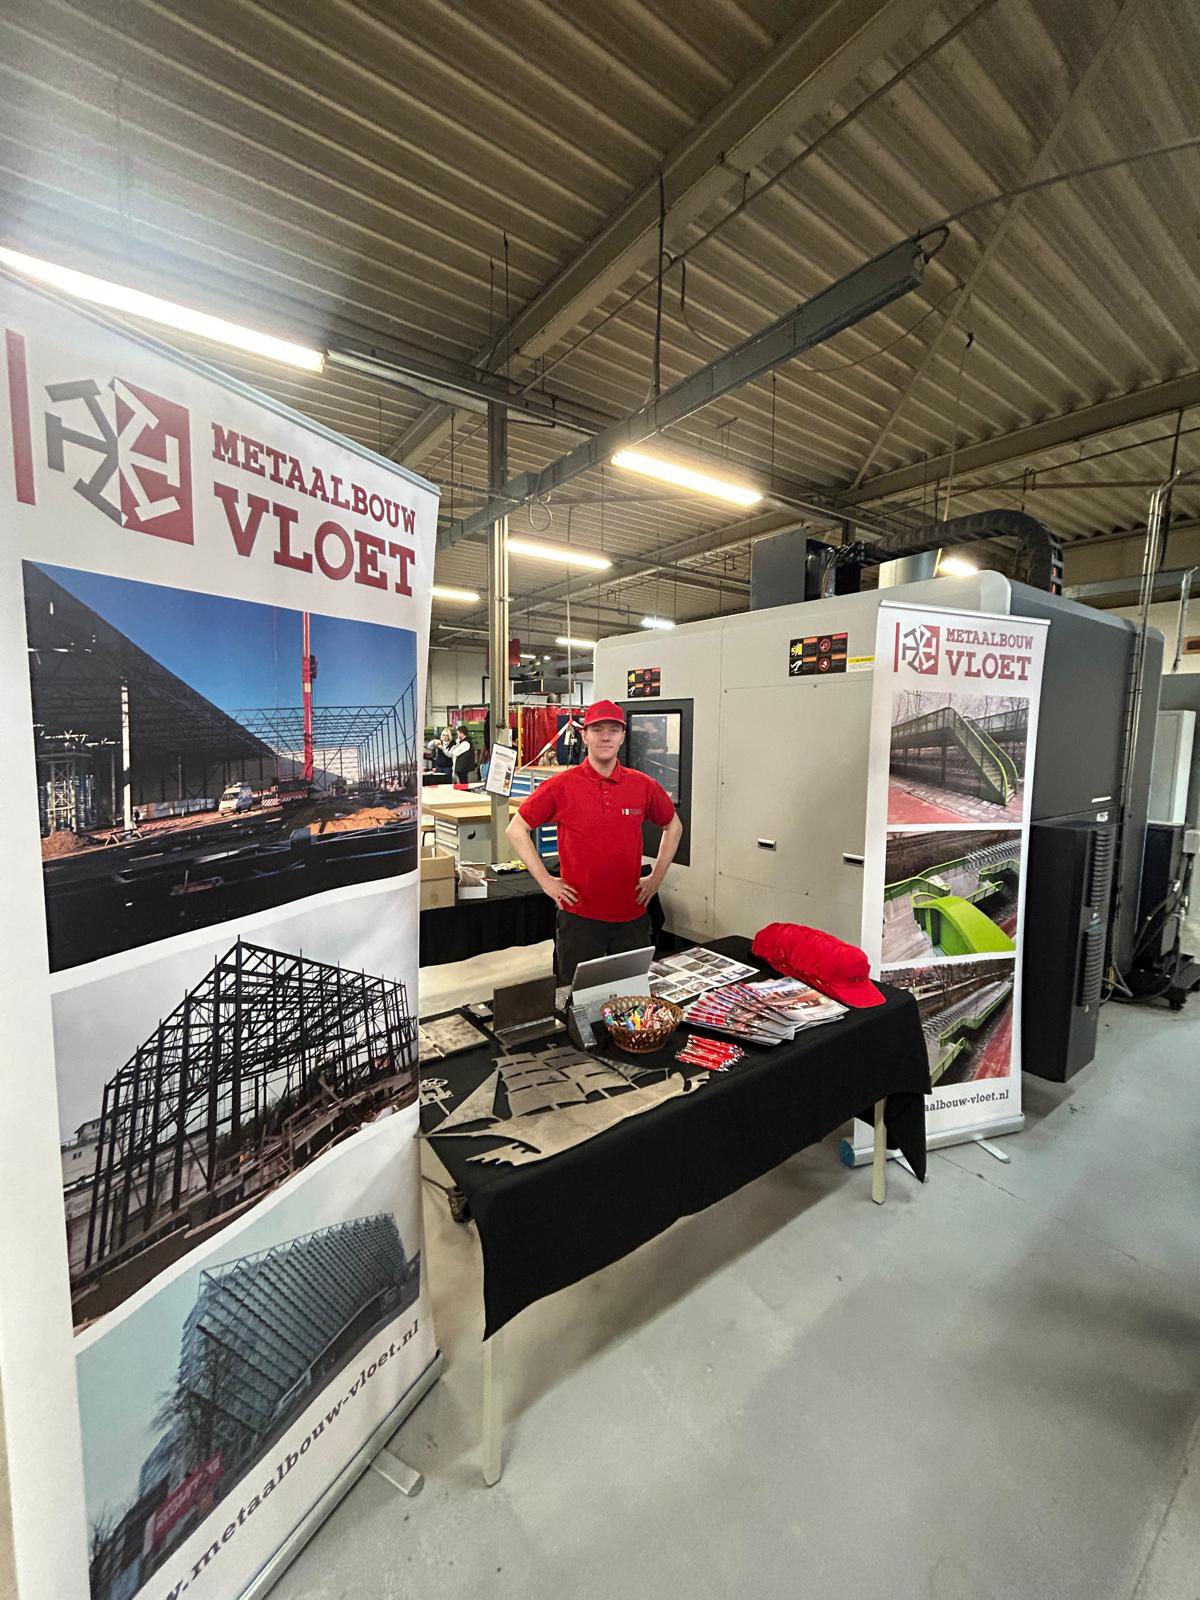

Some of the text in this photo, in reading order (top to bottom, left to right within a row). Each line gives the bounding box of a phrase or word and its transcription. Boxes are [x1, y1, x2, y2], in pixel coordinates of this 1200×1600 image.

[212, 422, 416, 535] METAALBOUW
[214, 481, 415, 597] VLOET
[945, 650, 1032, 680] VLOET
[946, 628, 1033, 650] METAALBOUW
